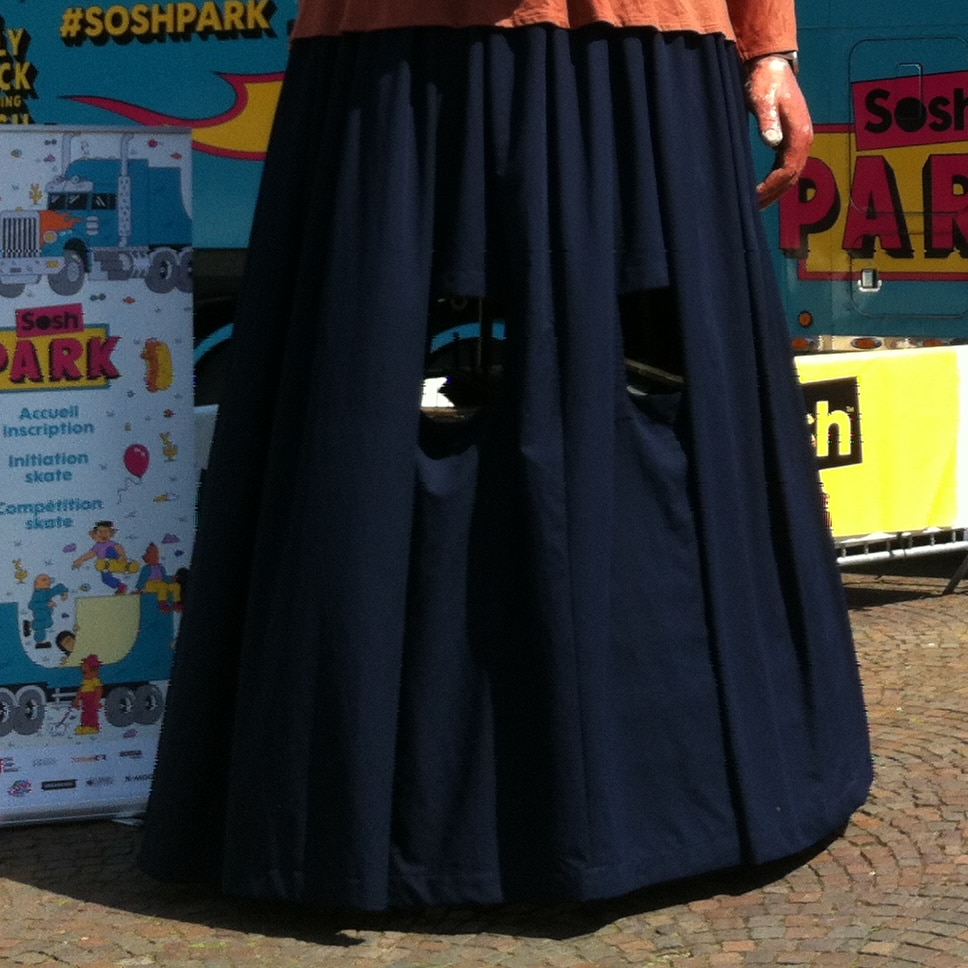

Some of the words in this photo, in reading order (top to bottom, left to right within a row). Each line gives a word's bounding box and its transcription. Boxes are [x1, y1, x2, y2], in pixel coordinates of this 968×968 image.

[21, 311, 80, 331] Sosh
[20, 405, 79, 420] Accueil
[806, 400, 852, 457] h
[9, 453, 89, 468] Initiation
[25, 470, 73, 484] skate
[25, 516, 74, 530] skate
